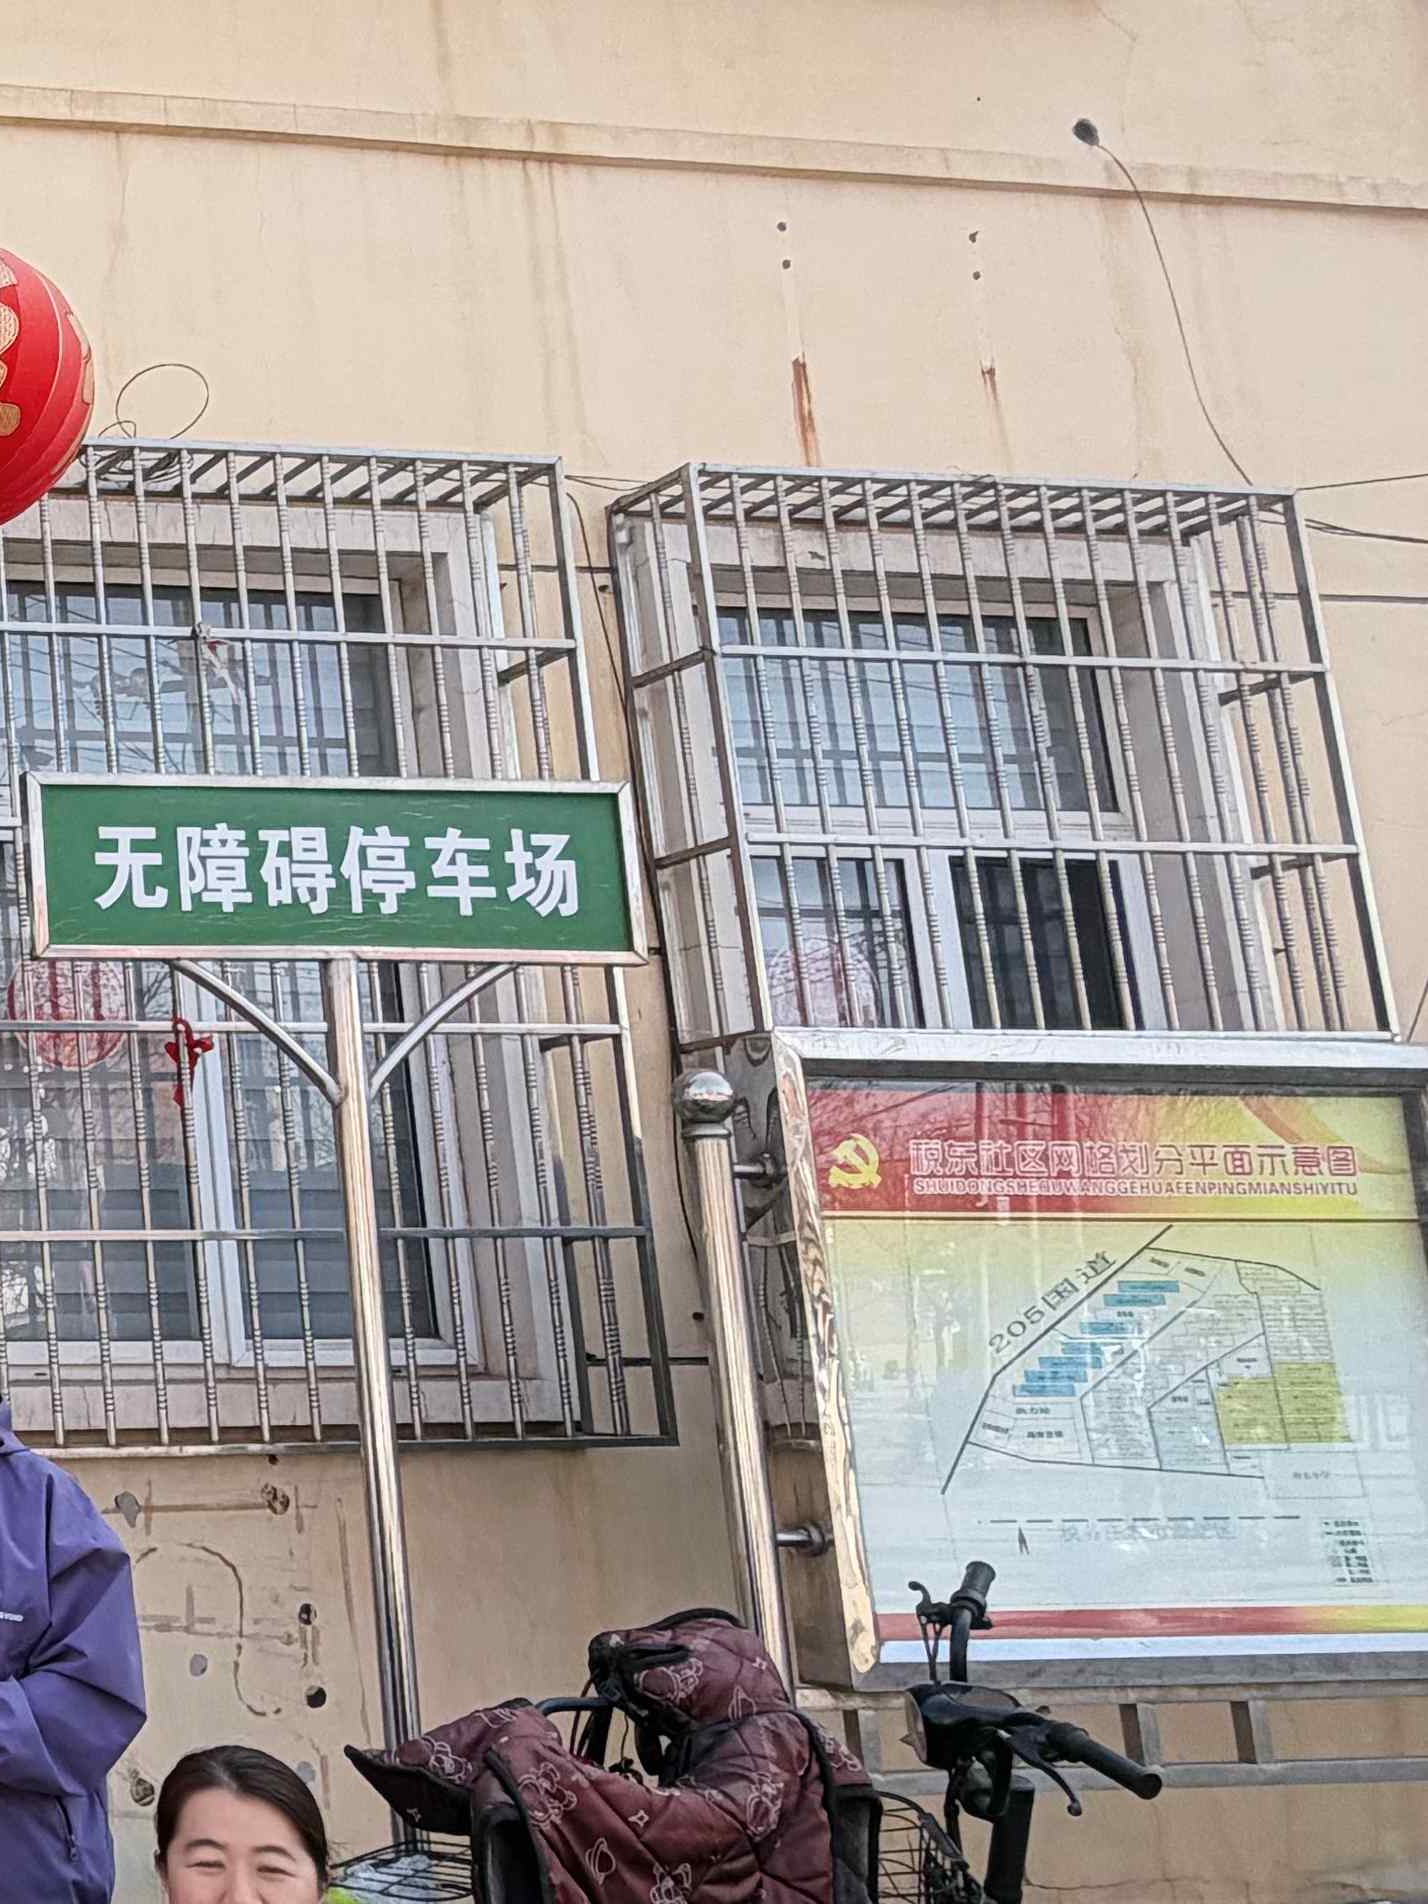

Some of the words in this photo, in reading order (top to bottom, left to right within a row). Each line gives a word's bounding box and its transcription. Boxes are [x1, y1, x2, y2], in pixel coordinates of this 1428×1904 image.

[93, 820, 580, 917] 无障碍停车场
[909, 1138, 1359, 1177] 税东社区网格划分平面示意图
[988, 1250, 1116, 1355] 205国道
